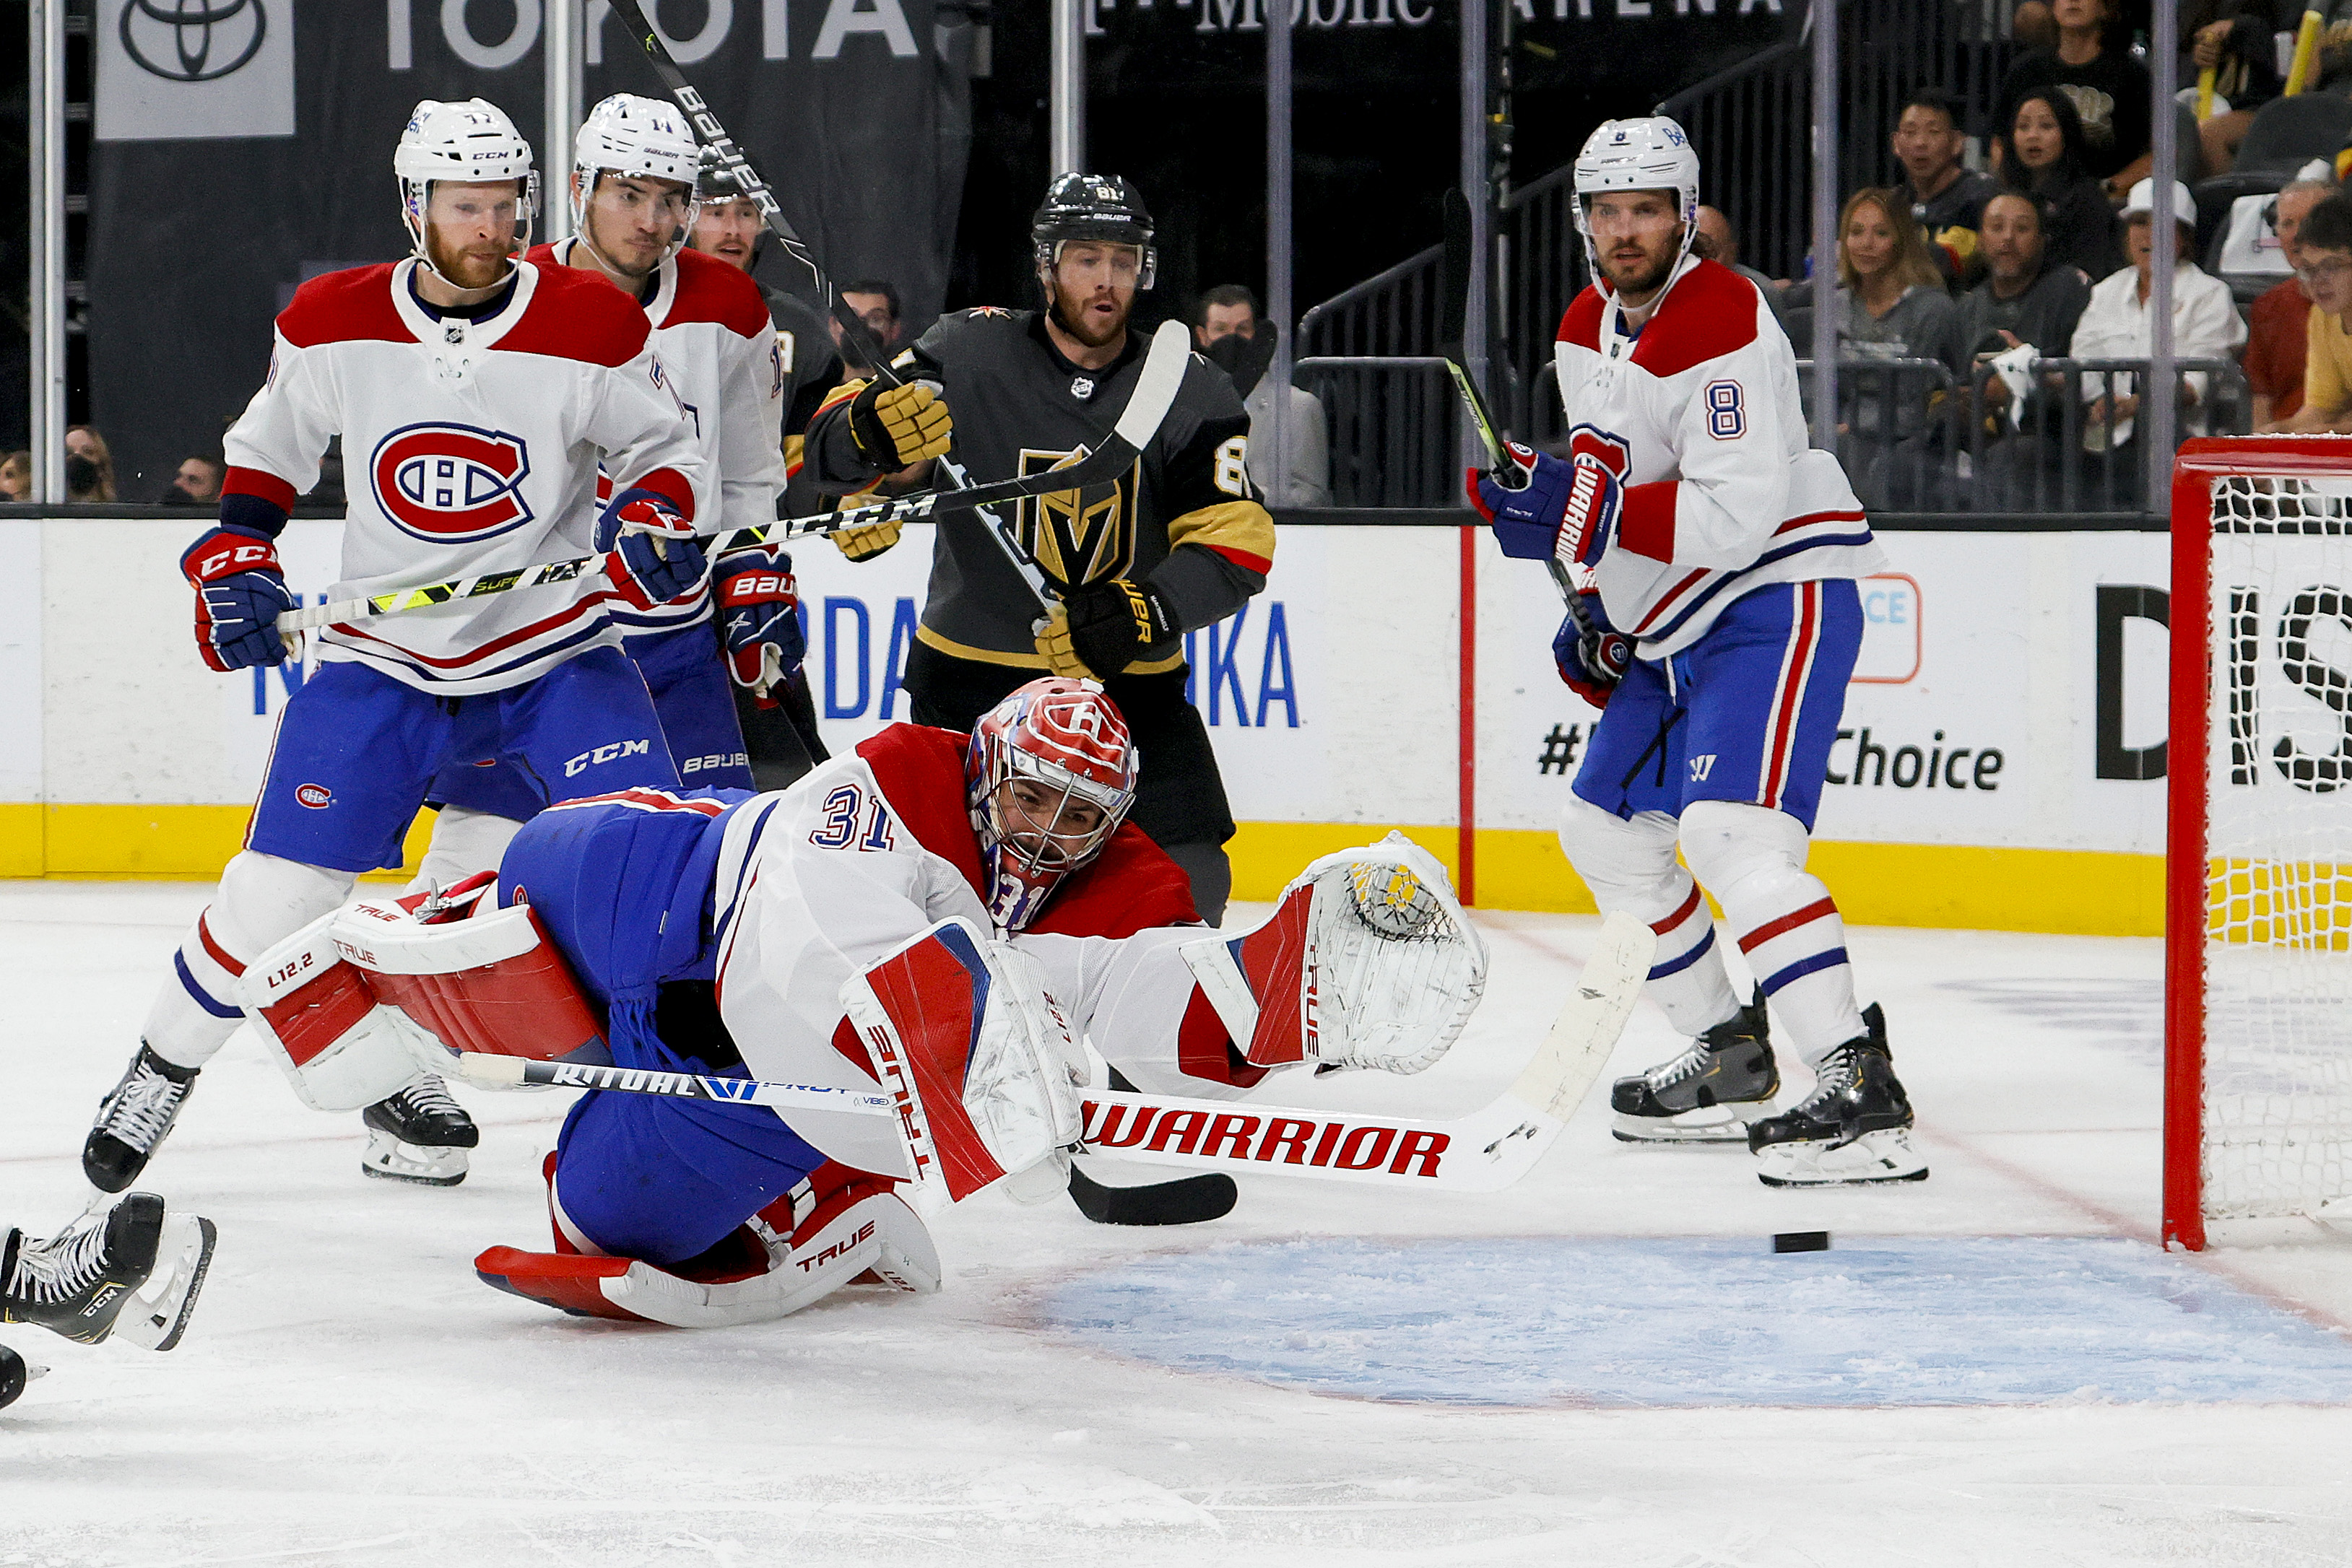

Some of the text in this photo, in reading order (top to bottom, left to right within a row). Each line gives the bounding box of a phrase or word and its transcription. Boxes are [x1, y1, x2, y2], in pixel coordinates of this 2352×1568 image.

[472, 152, 509, 160] CCM
[674, 85, 781, 217] BAUER
[1096, 186, 1120, 201] 81
[1704, 379, 1747, 441] 8
[1214, 435, 1253, 499] 8
[788, 494, 938, 536] CCM
[474, 575, 521, 593] SUPE
[732, 576, 795, 597] BAU
[1864, 591, 1907, 625] CE
[563, 739, 650, 778] CCM
[808, 783, 895, 853] 31
[353, 904, 402, 923] TRUE
[989, 872, 1046, 931] 31
[267, 951, 314, 989] L12.2
[332, 938, 378, 966] TRUE
[1306, 933, 1320, 1058] TRUE
[552, 1063, 697, 1097] RITUAL
[867, 1024, 931, 1182] TRUE
[1082, 1099, 1451, 1178] WARRIOR
[796, 1219, 875, 1273] TRUE
[82, 1288, 118, 1318] CCM
